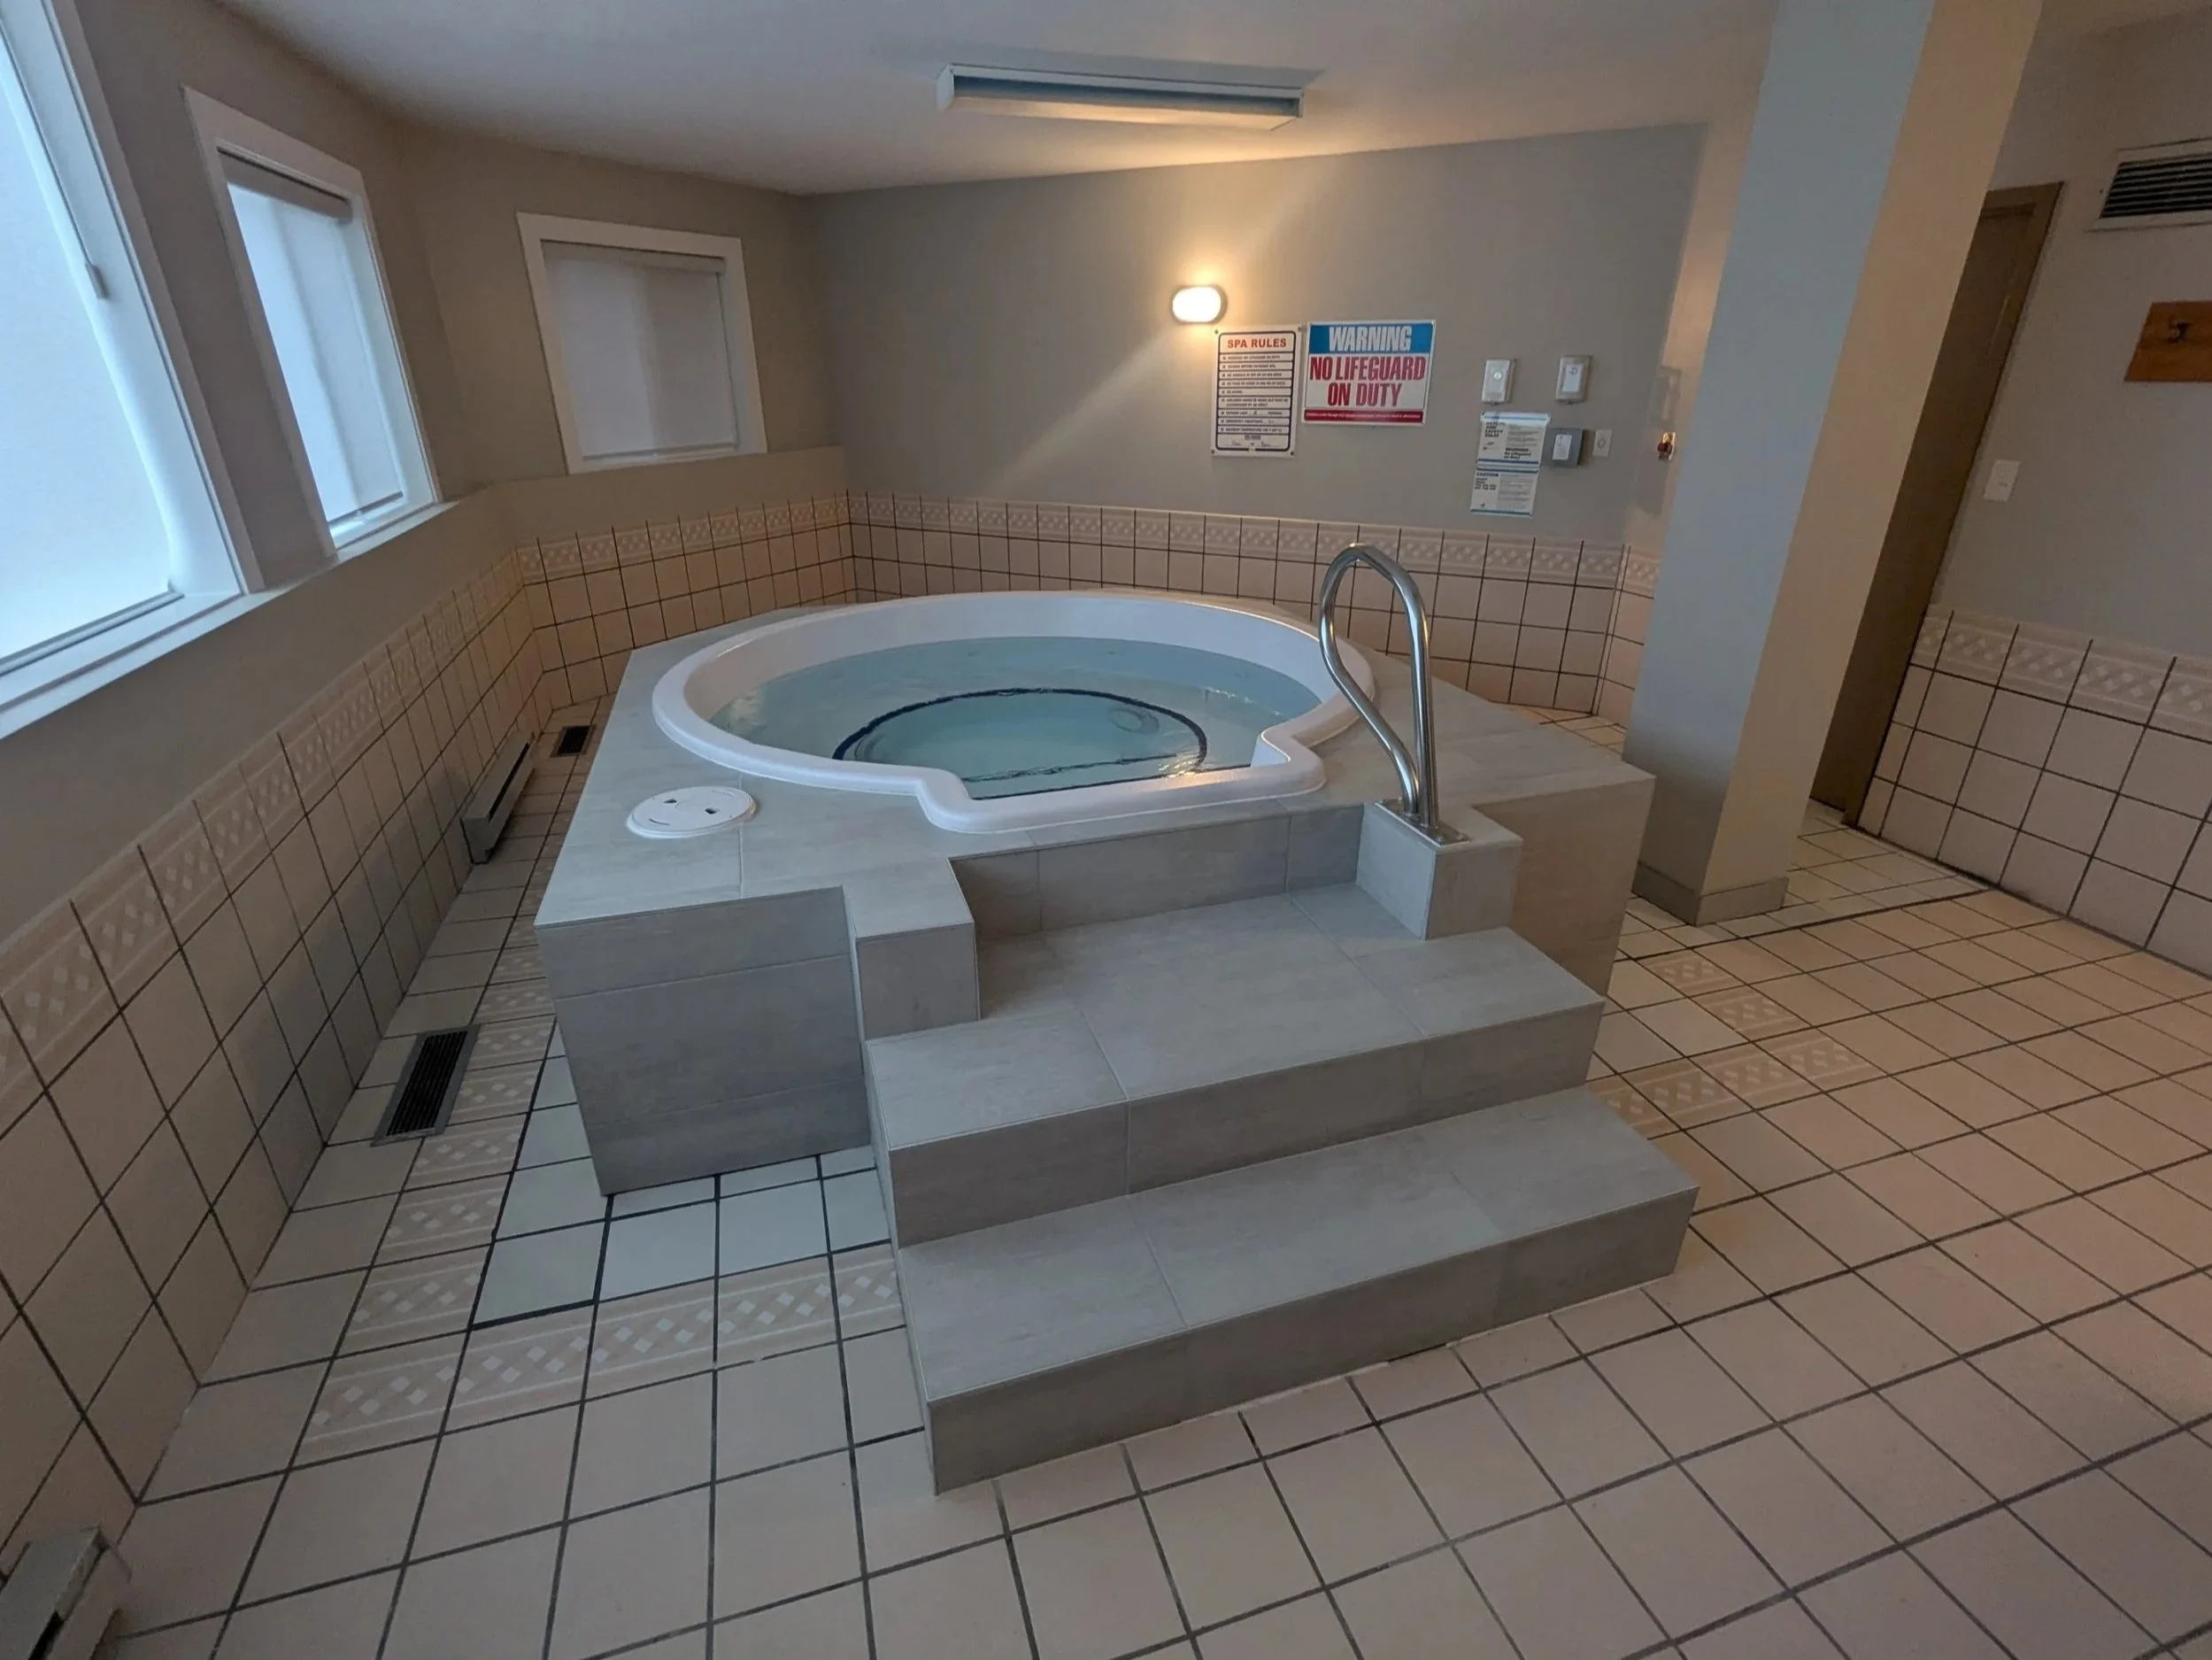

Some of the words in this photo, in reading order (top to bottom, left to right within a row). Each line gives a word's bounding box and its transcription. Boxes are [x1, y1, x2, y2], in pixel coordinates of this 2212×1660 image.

[1227, 338, 1247, 348] SPA
[1251, 338, 1287, 347] RULES
[1329, 325, 1412, 351] WARNING
[1309, 356, 1333, 381] NO
[1335, 356, 1427, 381] LIFEGUARD
[1328, 382, 1351, 406] ON
[1355, 382, 1402, 406] DUTY
